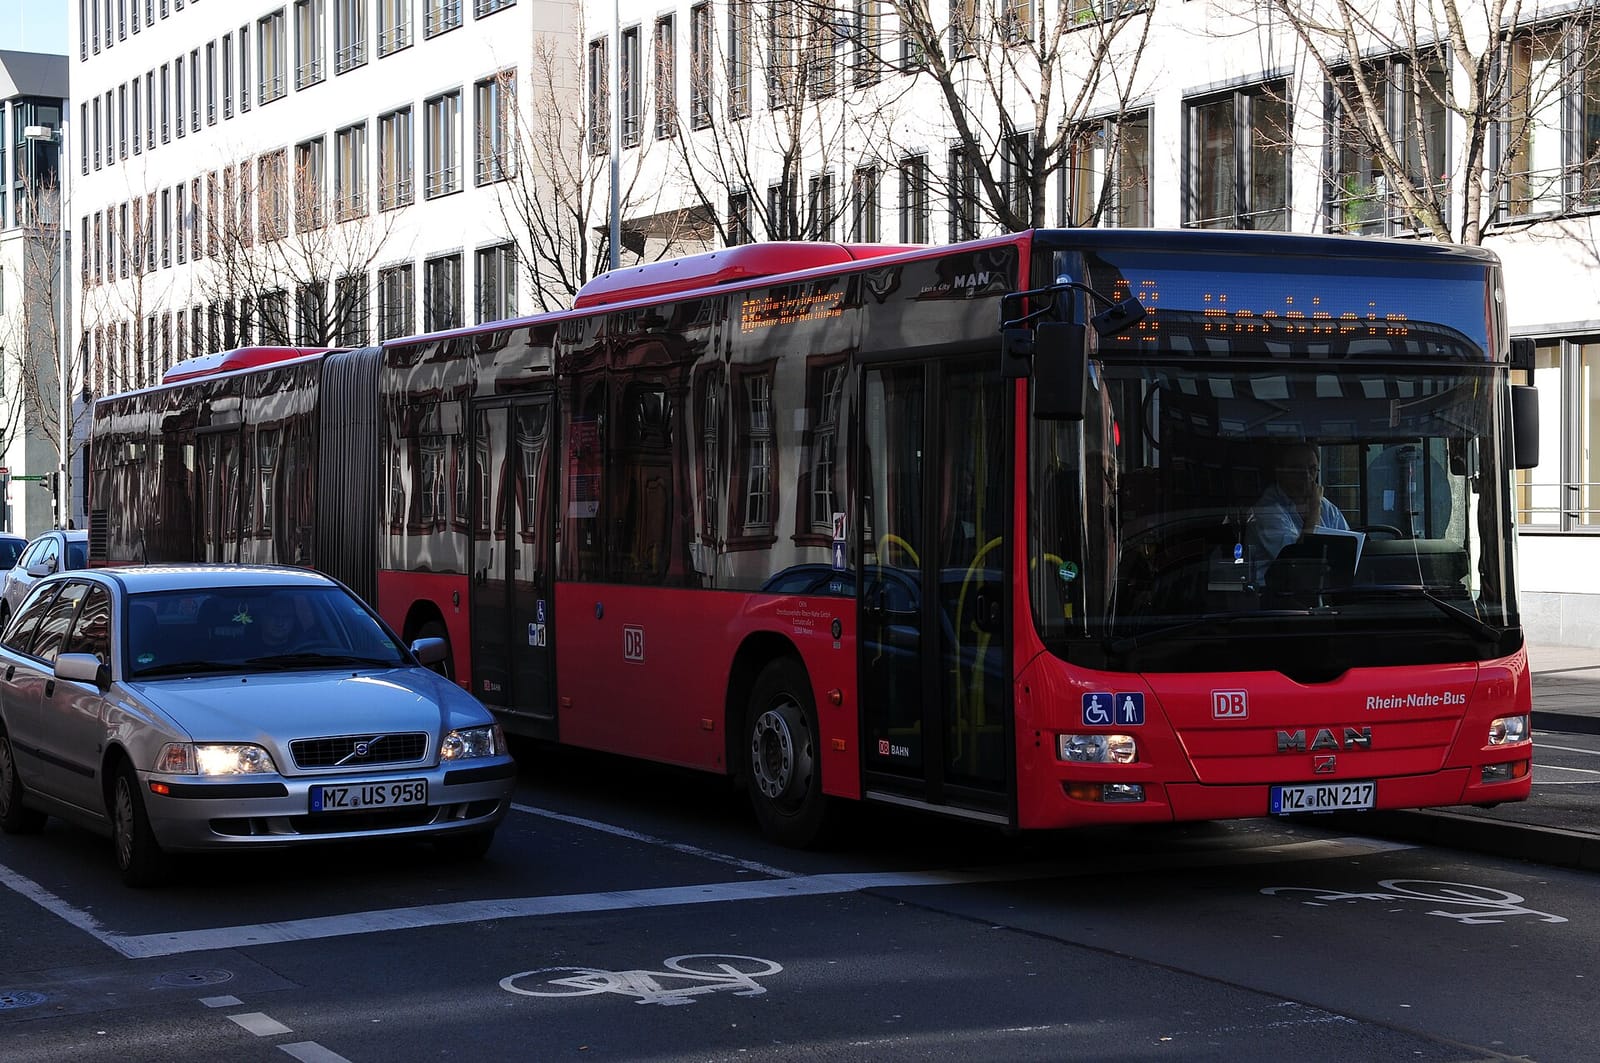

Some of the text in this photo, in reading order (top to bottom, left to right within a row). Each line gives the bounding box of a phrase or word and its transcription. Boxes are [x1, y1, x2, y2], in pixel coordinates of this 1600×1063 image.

[954, 271, 990, 288] MAN
[625, 629, 642, 658] DB
[1215, 693, 1246, 716] DB
[1366, 692, 1466, 710] Rhein-Nahe-Bus
[891, 744, 909, 756] BAHN
[1277, 726, 1373, 752] MAN
[323, 782, 425, 808] MZ US 958
[1282, 785, 1372, 809] MZ RN 217
